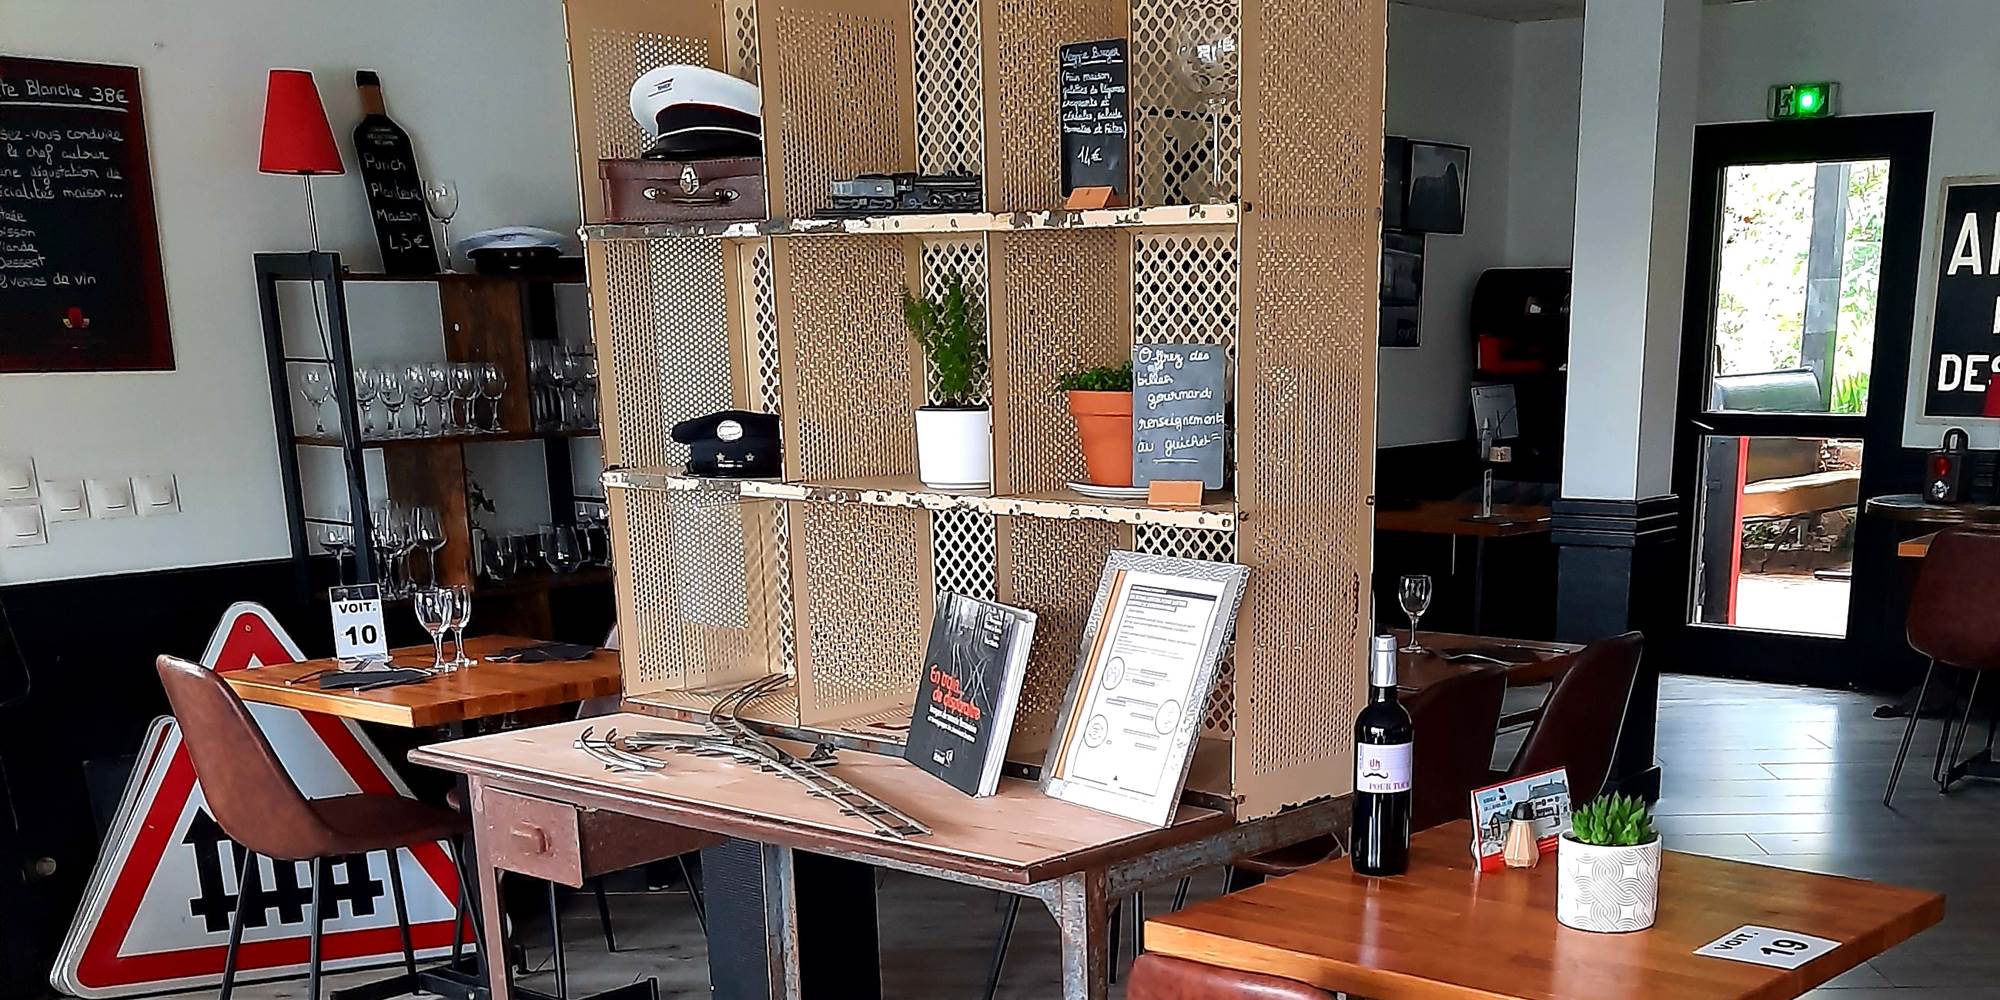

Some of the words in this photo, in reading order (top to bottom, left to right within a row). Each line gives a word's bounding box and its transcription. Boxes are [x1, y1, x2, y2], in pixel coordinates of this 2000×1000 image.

[26, 79, 83, 98] Blanche
[89, 86, 129, 103] 38€
[26, 143, 54, 166] chef
[363, 151, 407, 171] Punch
[1946, 212, 2000, 275] A
[74, 274, 97, 286] vin
[1189, 350, 1211, 361] des
[338, 602, 377, 614] VOIT.
[345, 624, 378, 646] 10
[1714, 932, 1759, 950] VOIT.
[1760, 939, 1809, 956] 19
